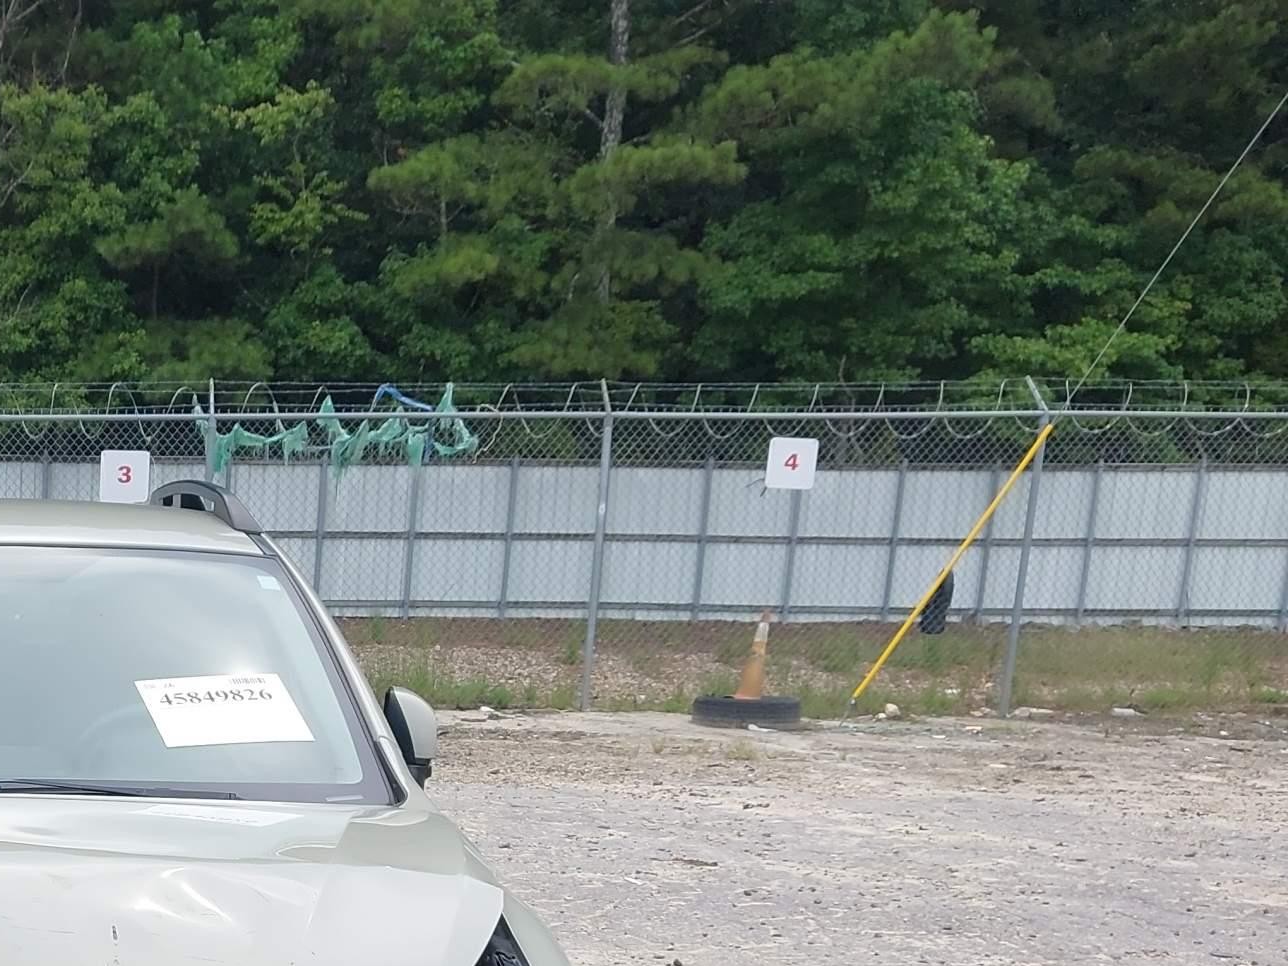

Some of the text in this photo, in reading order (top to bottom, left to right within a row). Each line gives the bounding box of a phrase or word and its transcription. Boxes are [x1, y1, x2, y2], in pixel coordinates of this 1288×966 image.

[784, 453, 799, 471] 4
[117, 465, 132, 484] 3
[159, 688, 273, 706] 45849826
